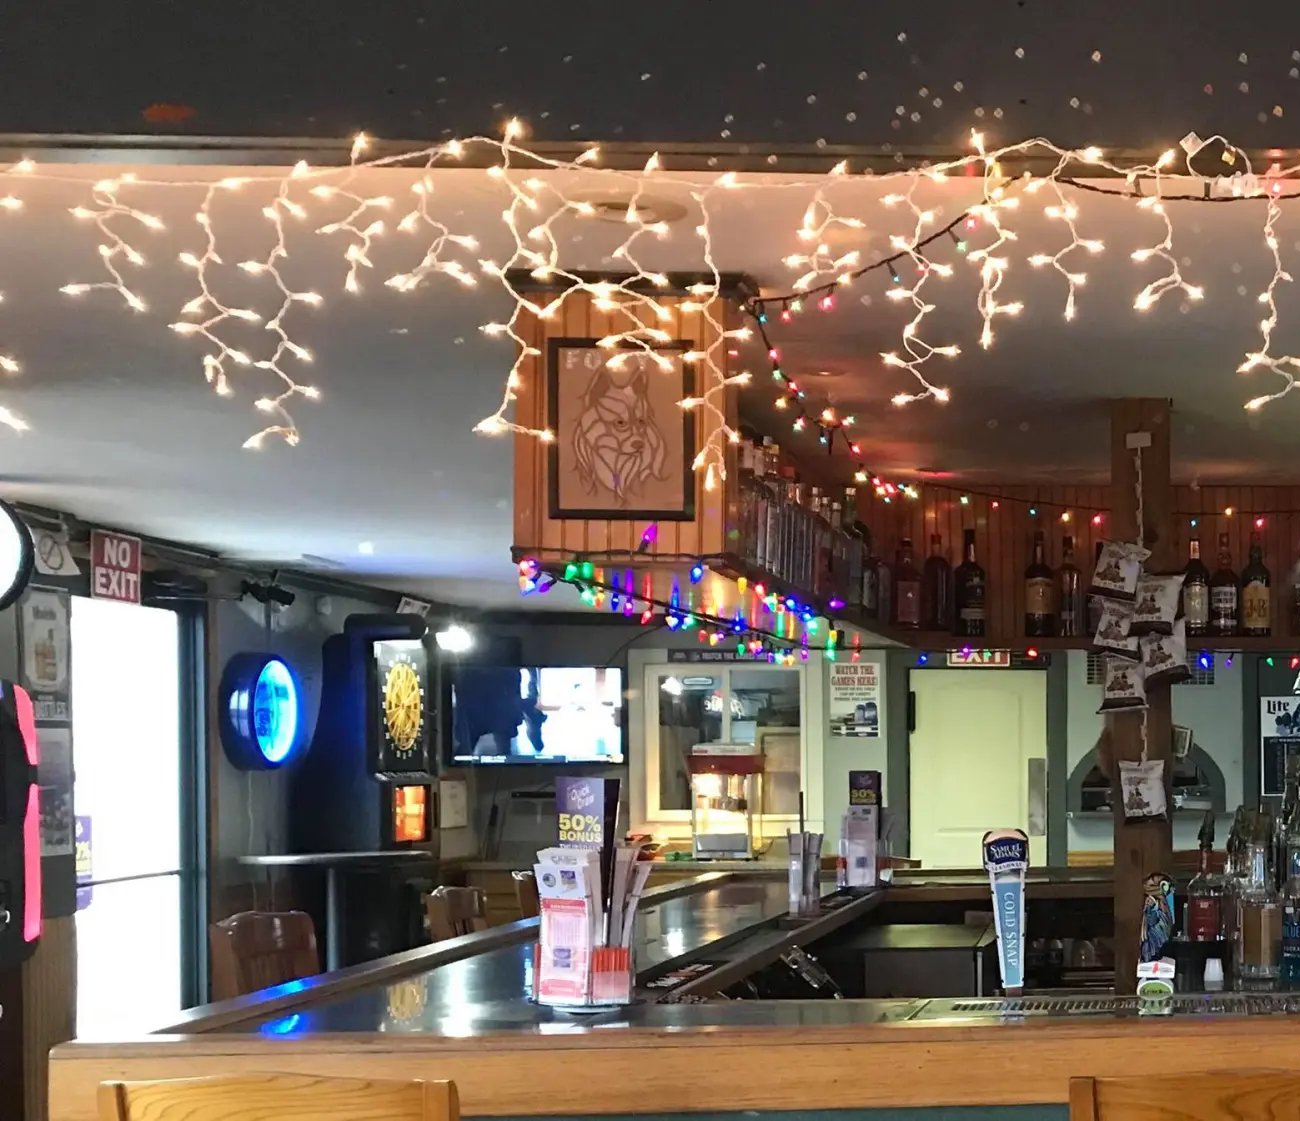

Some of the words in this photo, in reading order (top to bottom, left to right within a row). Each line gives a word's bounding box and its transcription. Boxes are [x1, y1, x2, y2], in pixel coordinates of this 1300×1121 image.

[103, 537, 131, 568] NO
[95, 566, 138, 599] EXIT
[950, 650, 1002, 664] EXIT
[834, 665, 858, 676] WATCH
[859, 664, 874, 676] THE
[831, 676, 855, 686] GAMES
[1266, 700, 1289, 715] Lite
[559, 813, 601, 832] 50%
[559, 830, 602, 843] BONUS
[989, 843, 1023, 853] SAMUEL
[993, 850, 1021, 860] ADAMS
[1004, 892, 1016, 928] COLD
[1006, 931, 1018, 968] SNAP
